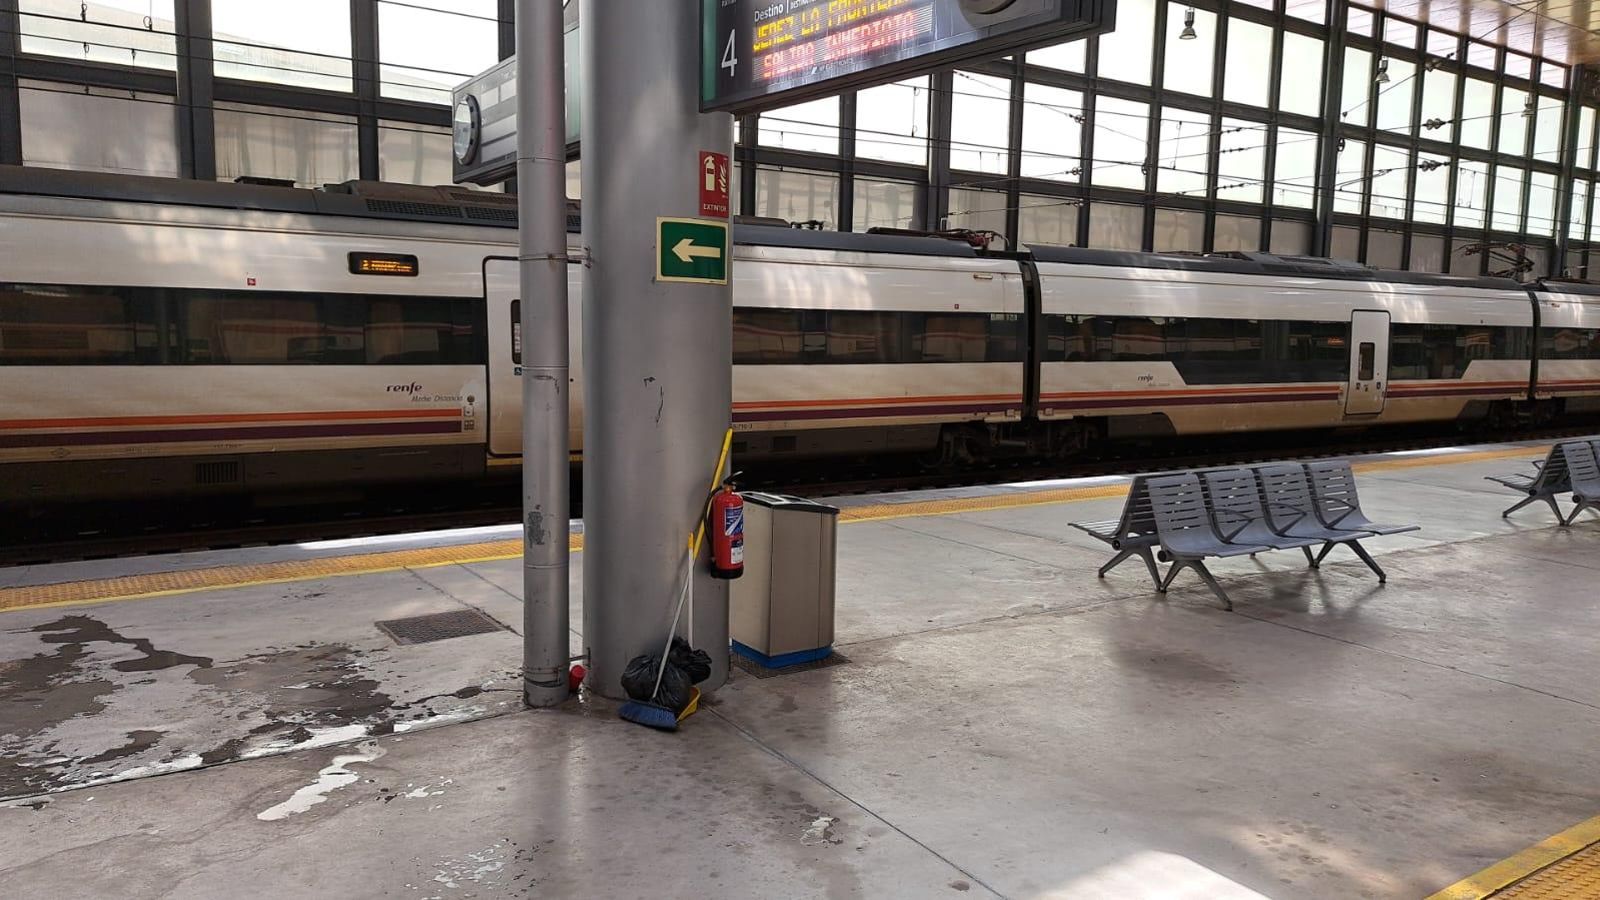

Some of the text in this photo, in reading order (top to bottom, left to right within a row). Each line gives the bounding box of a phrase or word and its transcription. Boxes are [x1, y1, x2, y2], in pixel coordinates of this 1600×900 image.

[754, 4, 784, 22] Destino
[721, 28, 738, 77] 4
[703, 203, 727, 212] EXTINTOR
[386, 381, 423, 395] renfe
